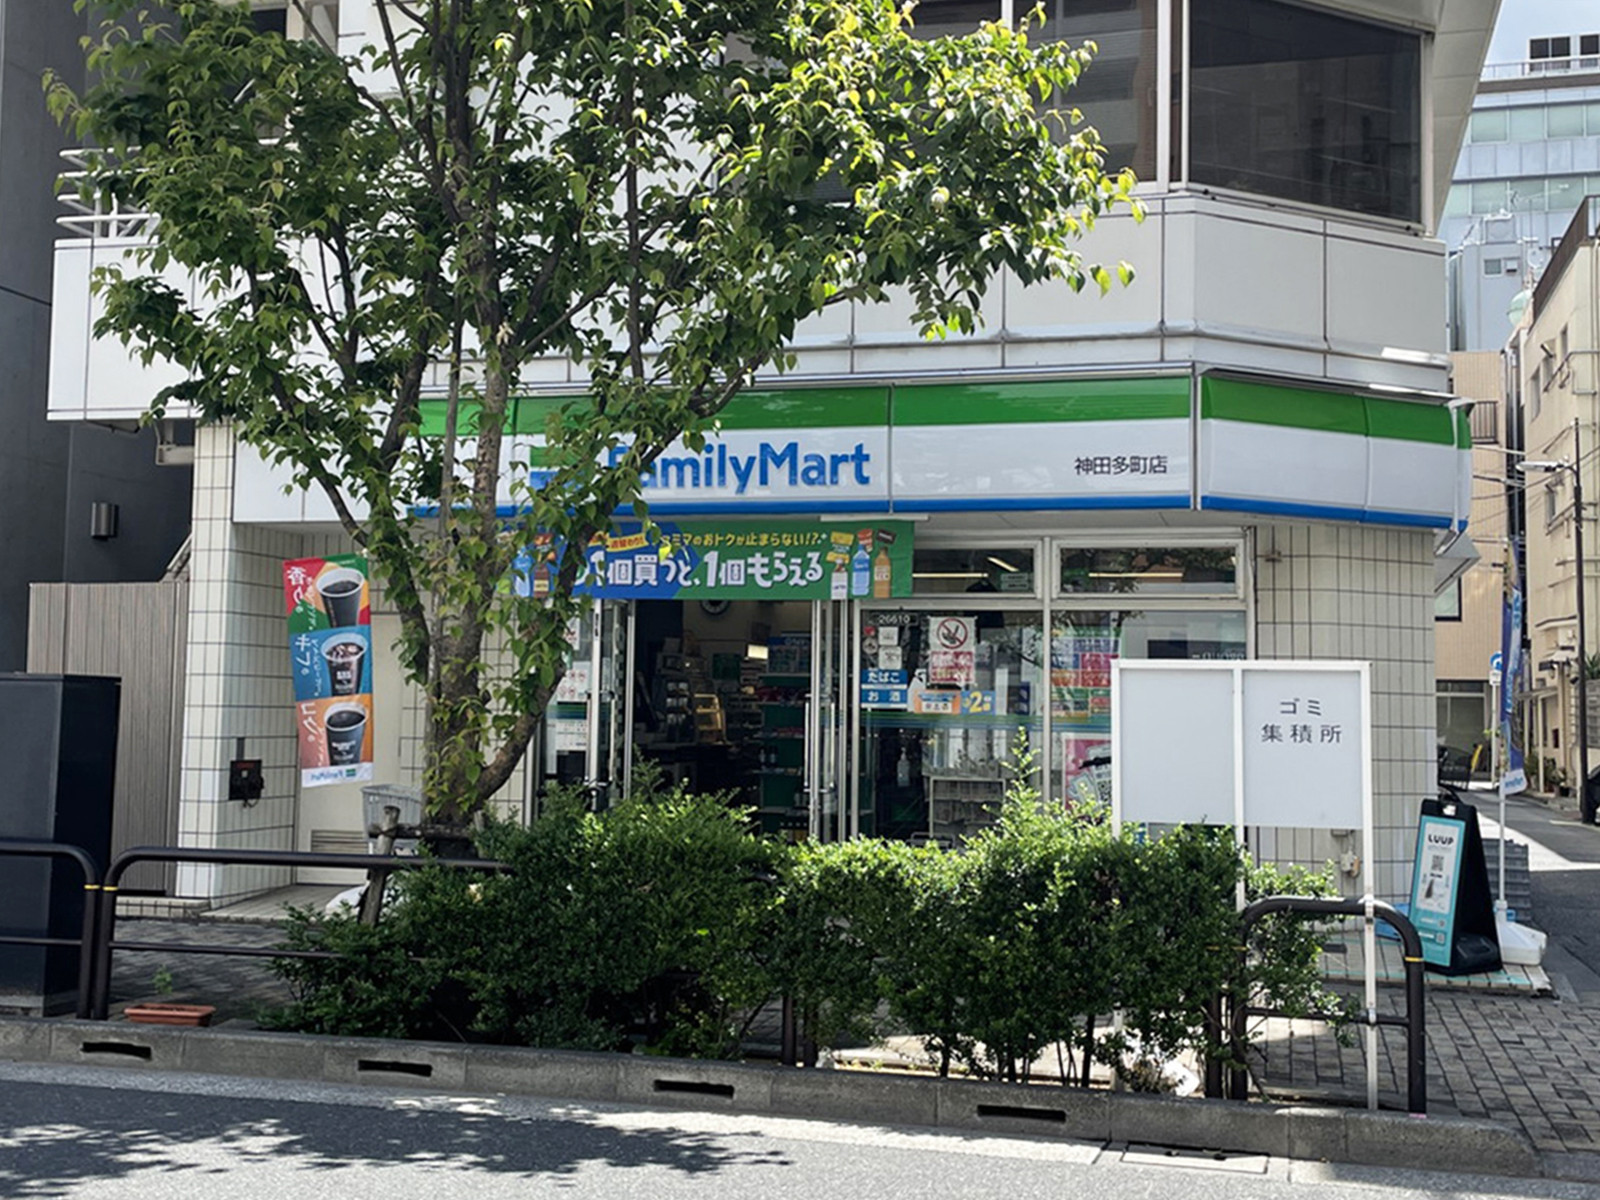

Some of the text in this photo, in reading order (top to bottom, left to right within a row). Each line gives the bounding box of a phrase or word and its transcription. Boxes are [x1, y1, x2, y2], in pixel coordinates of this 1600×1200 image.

[1074, 455, 1168, 475] 神田多町店
[868, 670, 900, 683] たばこ
[1280, 698, 1321, 716] ゴミ
[1261, 724, 1341, 743] 集積所
[1427, 834, 1455, 846] LUUP
